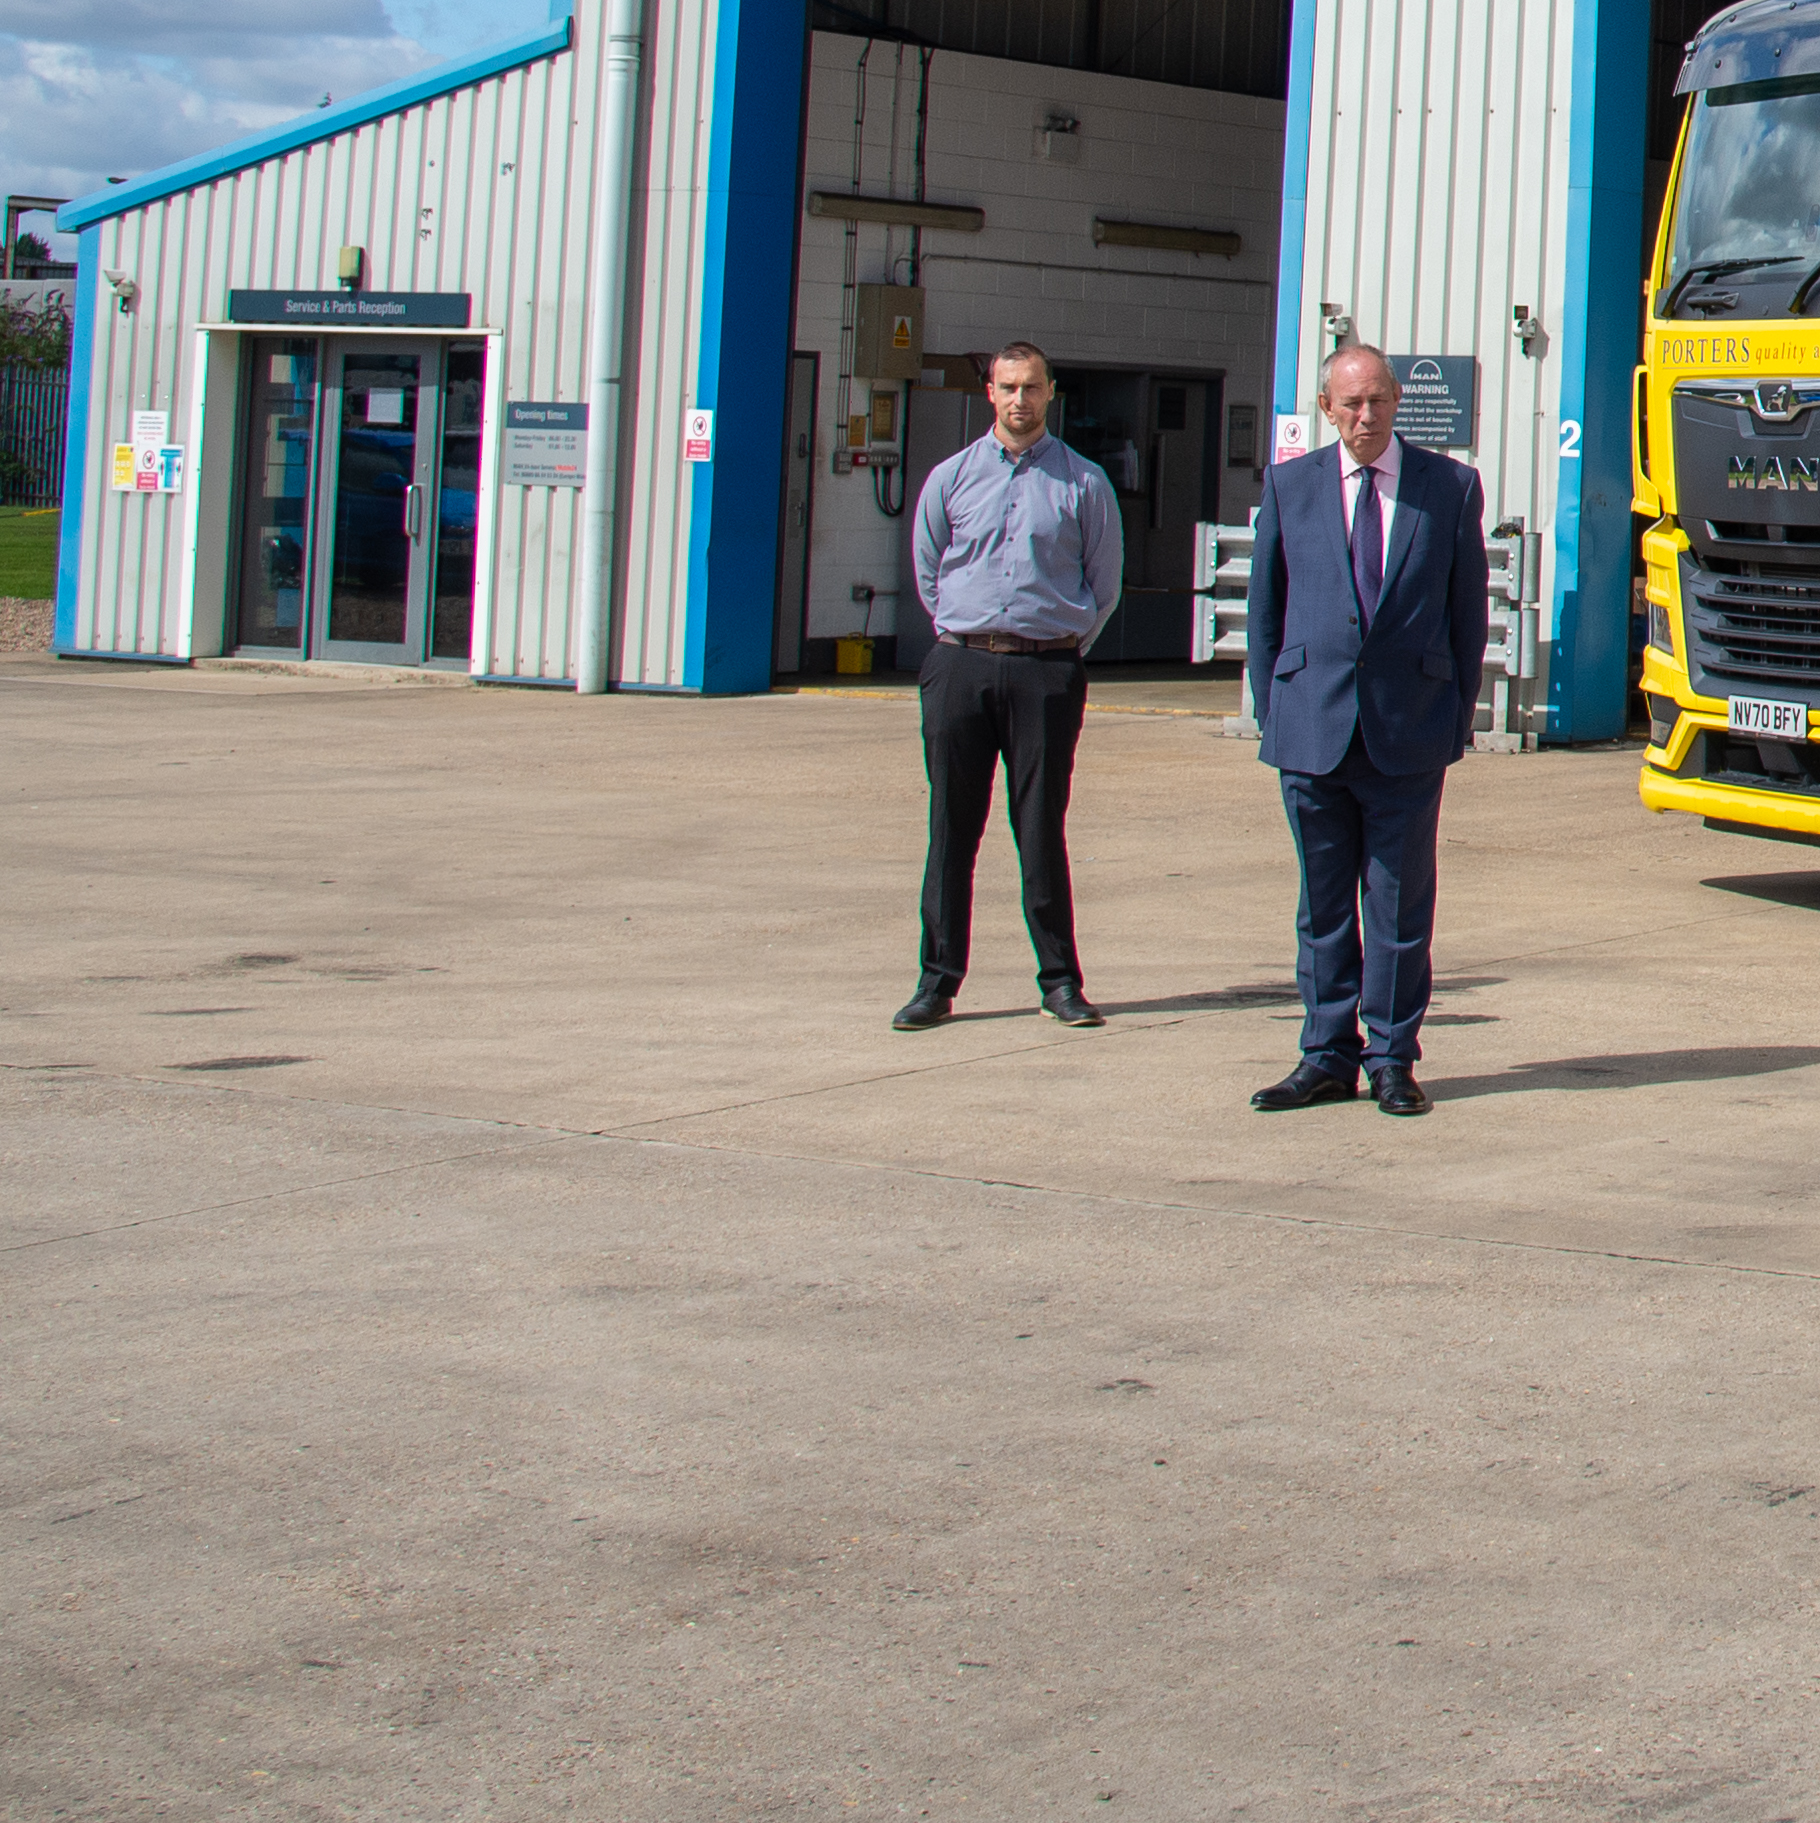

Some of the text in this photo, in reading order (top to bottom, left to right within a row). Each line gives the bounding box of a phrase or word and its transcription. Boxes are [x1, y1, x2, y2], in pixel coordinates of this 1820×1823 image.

[285, 299, 406, 317] Service & Parts Reception
[1662, 337, 1751, 364] PORTERS
[1755, 342, 1807, 364] quality
[1401, 384, 1449, 395] WARNING
[514, 408, 569, 422] Opening times
[1558, 419, 1582, 458] 2
[1727, 455, 1820, 492] MAN
[1734, 700, 1801, 732] NV70 BFY
